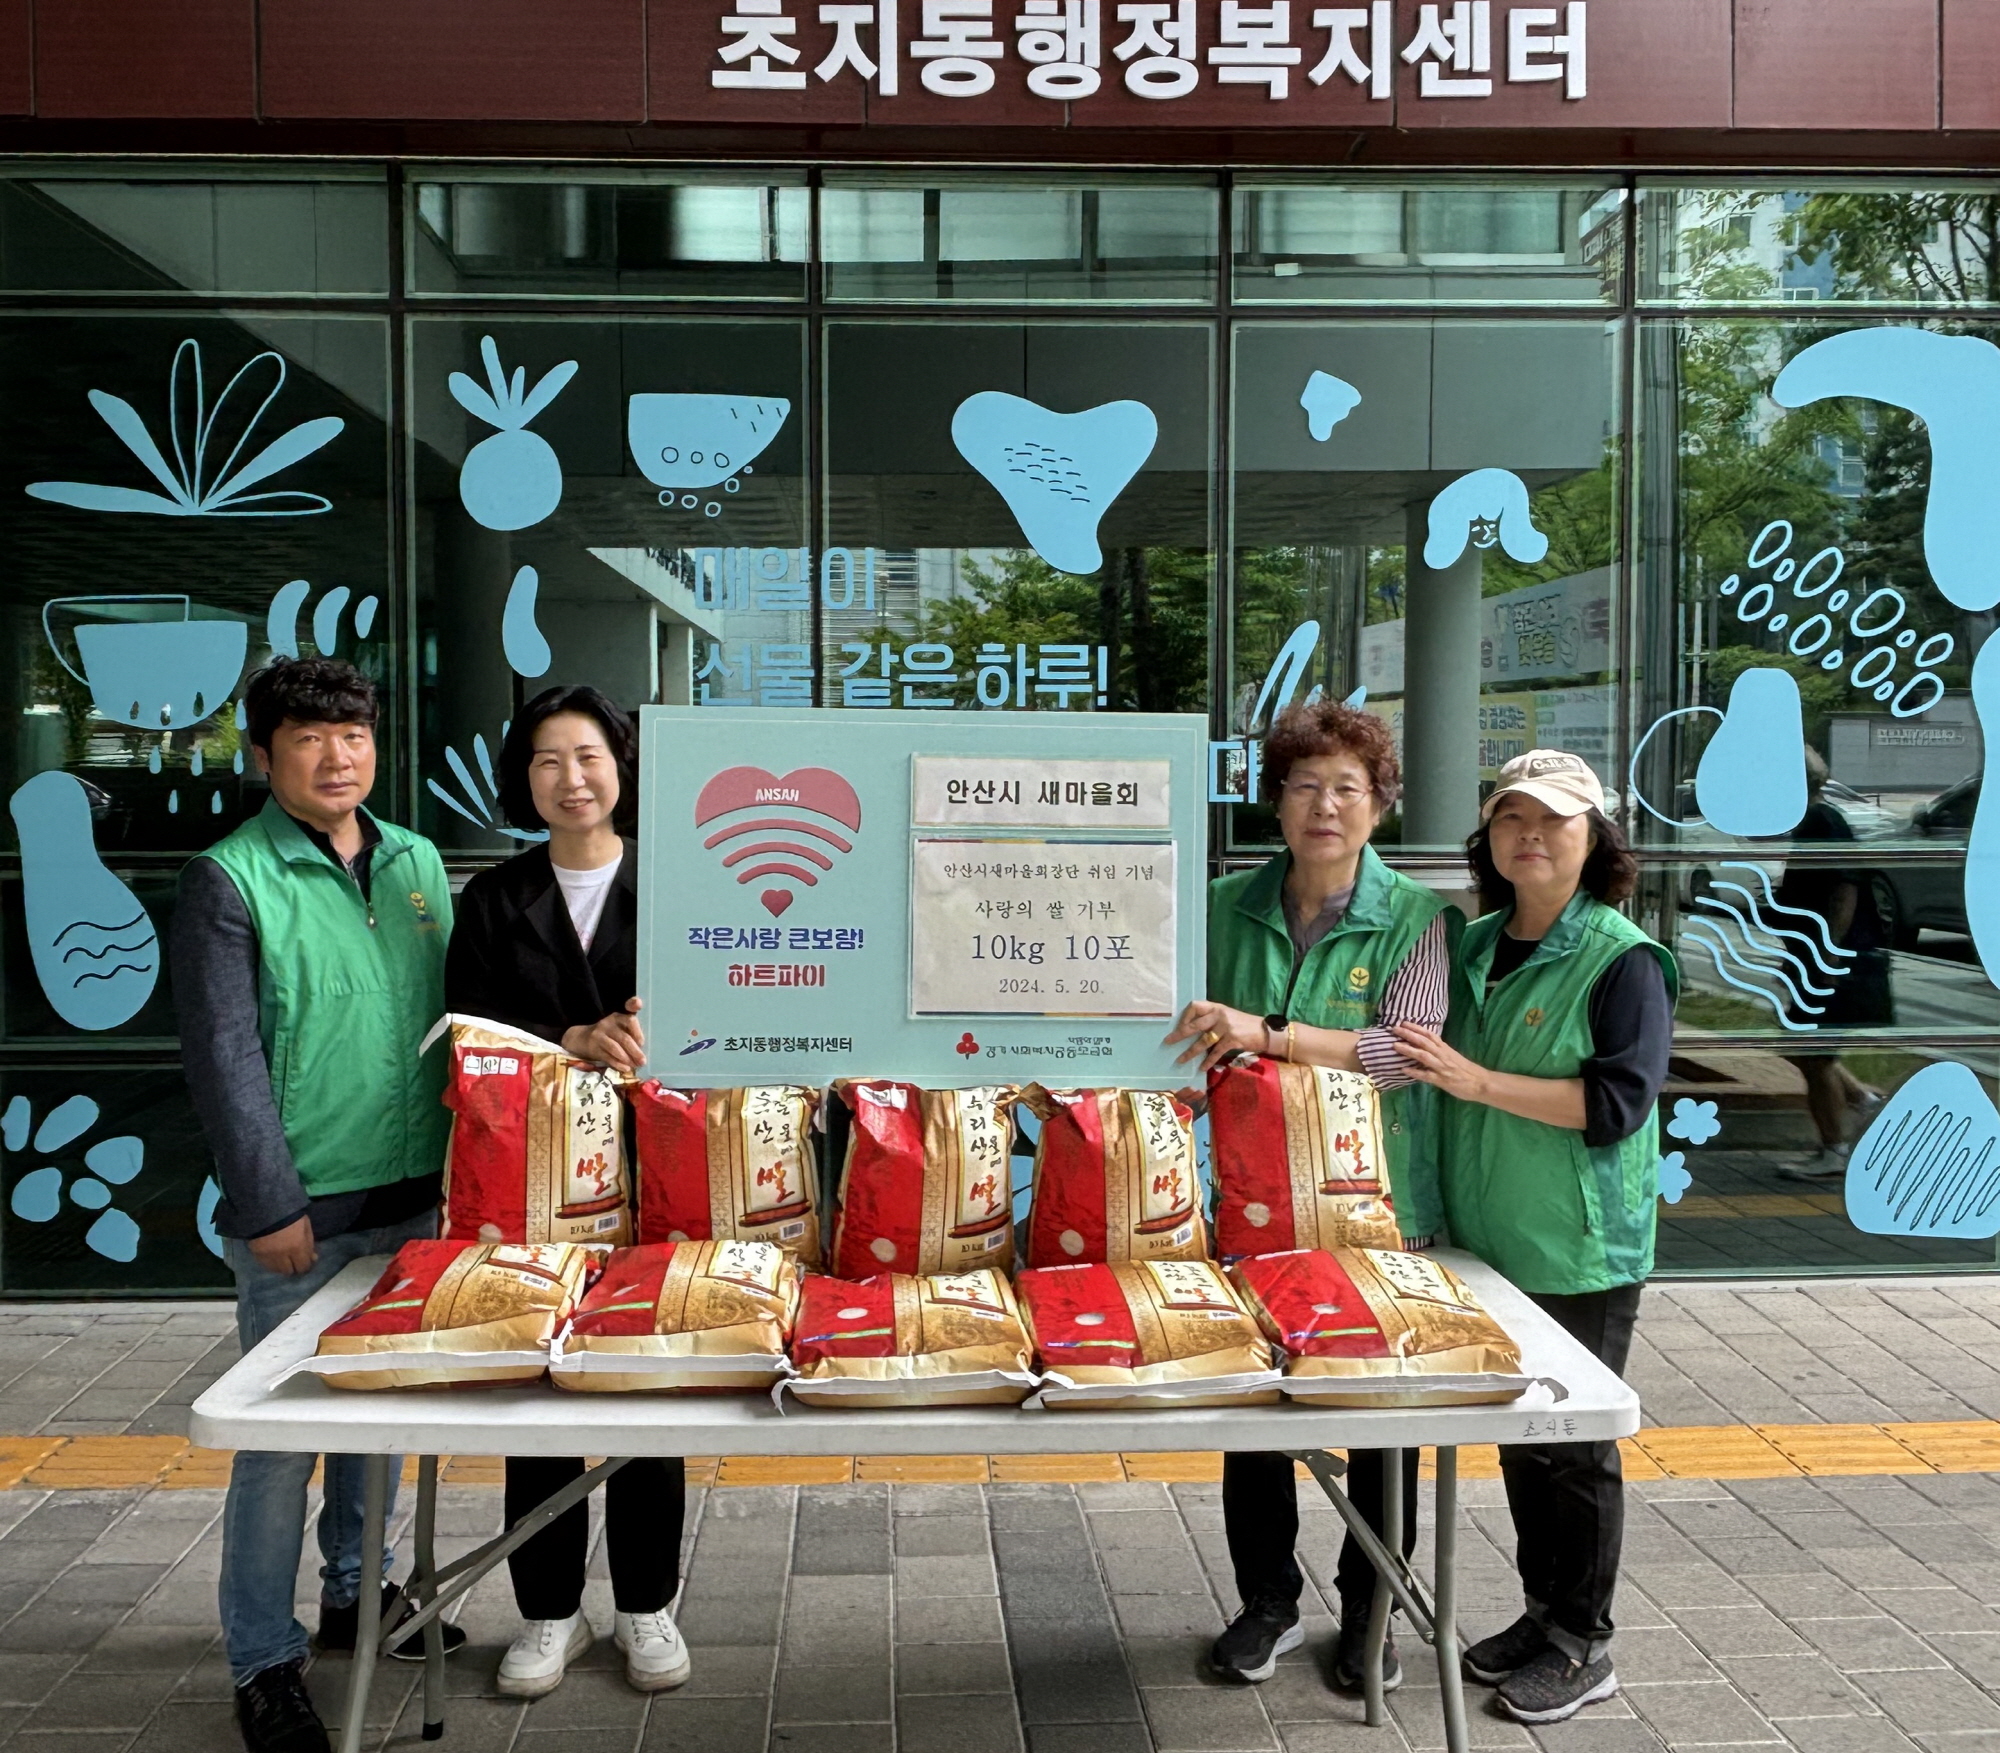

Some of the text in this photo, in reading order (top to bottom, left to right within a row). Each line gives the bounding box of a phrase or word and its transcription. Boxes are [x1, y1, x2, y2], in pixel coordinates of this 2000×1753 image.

[711, 0, 1587, 99] 초지동행정복지센터
[695, 546, 876, 610] 매일이
[696, 643, 1109, 709] 선물 같은 하루!
[755, 787, 799, 802] ANSAN
[947, 779, 1139, 807] 안산시 새마을회
[944, 863, 1154, 881] 안산시새마을회장단 취임 기념
[974, 900, 1116, 920] 사랑의 쌀 기부
[688, 927, 865, 950] 작은사랑 큰보람!
[971, 935, 1134, 965] 10kg 10포
[727, 963, 826, 988] 하트파이
[999, 978, 1105, 994] 2024. 5. 20.
[724, 1036, 853, 1054] 초지동행정복지센터
